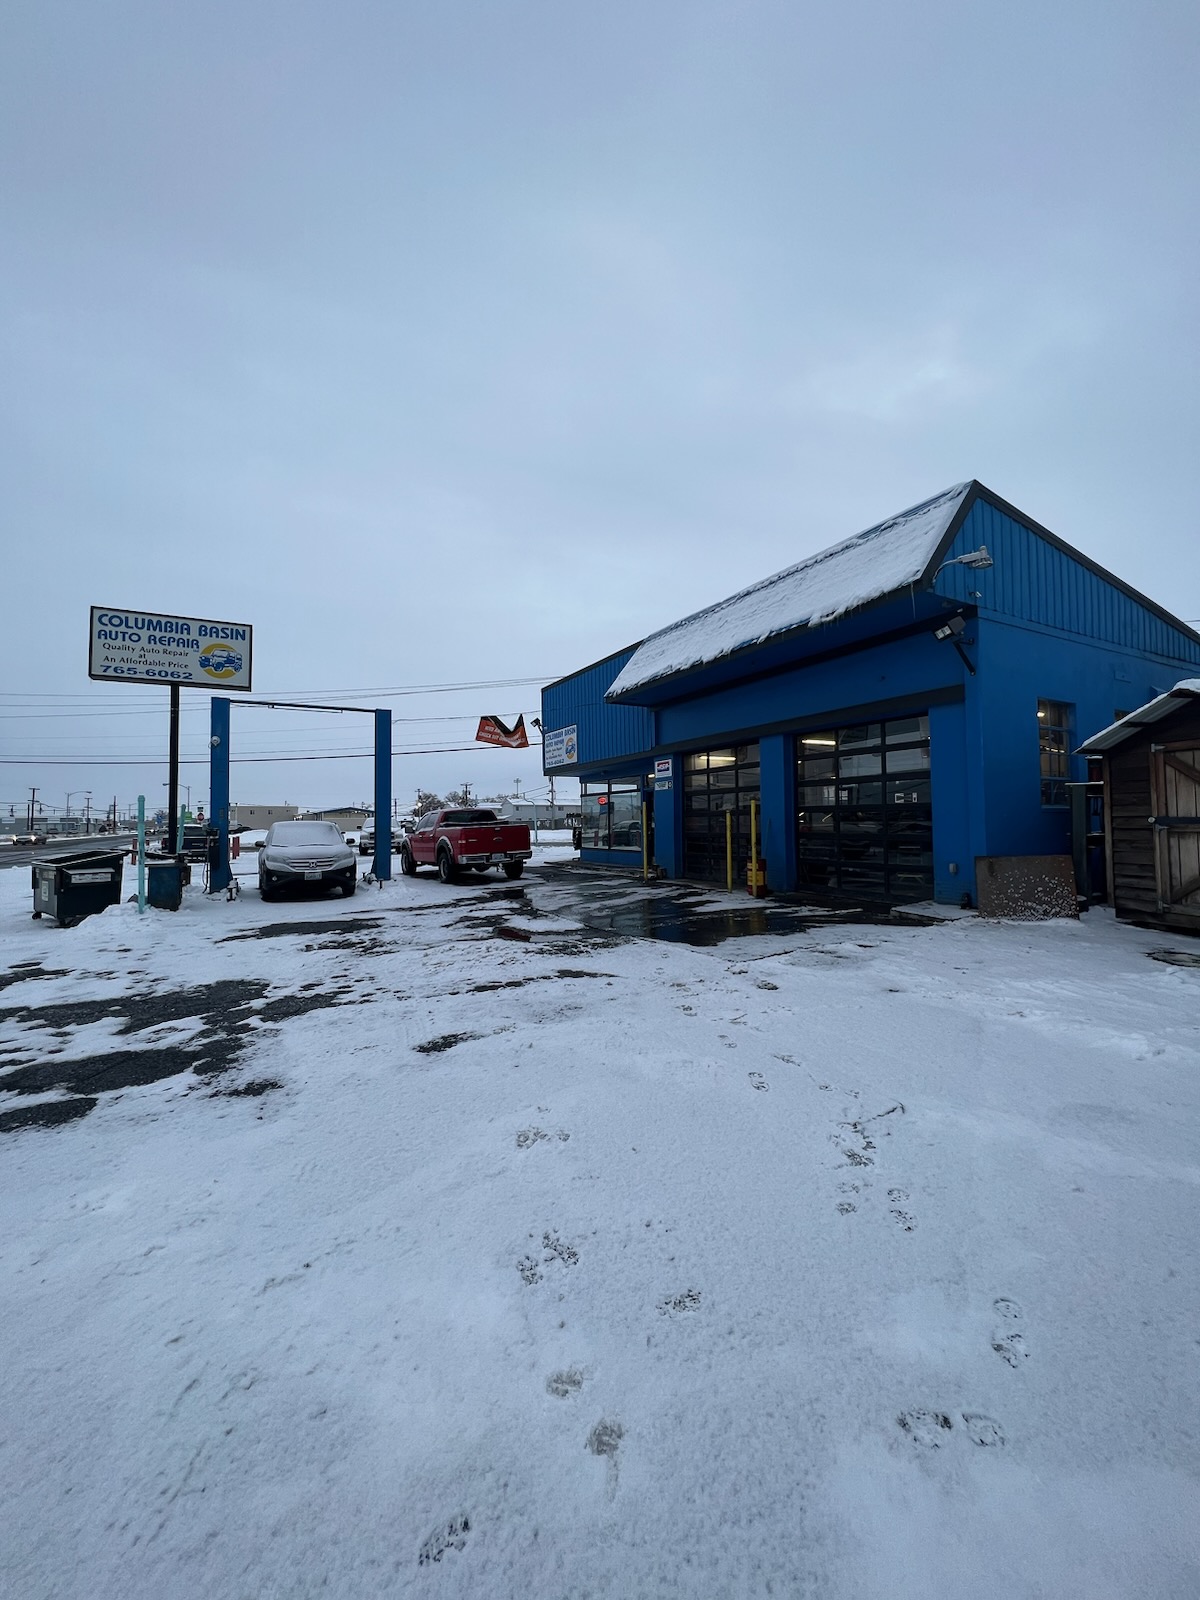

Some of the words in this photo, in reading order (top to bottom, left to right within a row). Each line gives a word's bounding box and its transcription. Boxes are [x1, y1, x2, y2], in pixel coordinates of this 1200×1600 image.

[97, 613, 191, 635] COLUMBIA
[198, 625, 246, 641] BASIN
[97, 629, 141, 643] AUTO
[148, 634, 200, 649] REPAIR
[102, 642, 136, 653] Quality
[139, 646, 160, 654] Auto
[162, 648, 189, 657] Repair
[118, 657, 166, 667] Affordable
[168, 661, 189, 669] Price
[100, 664, 193, 680] 765-6062
